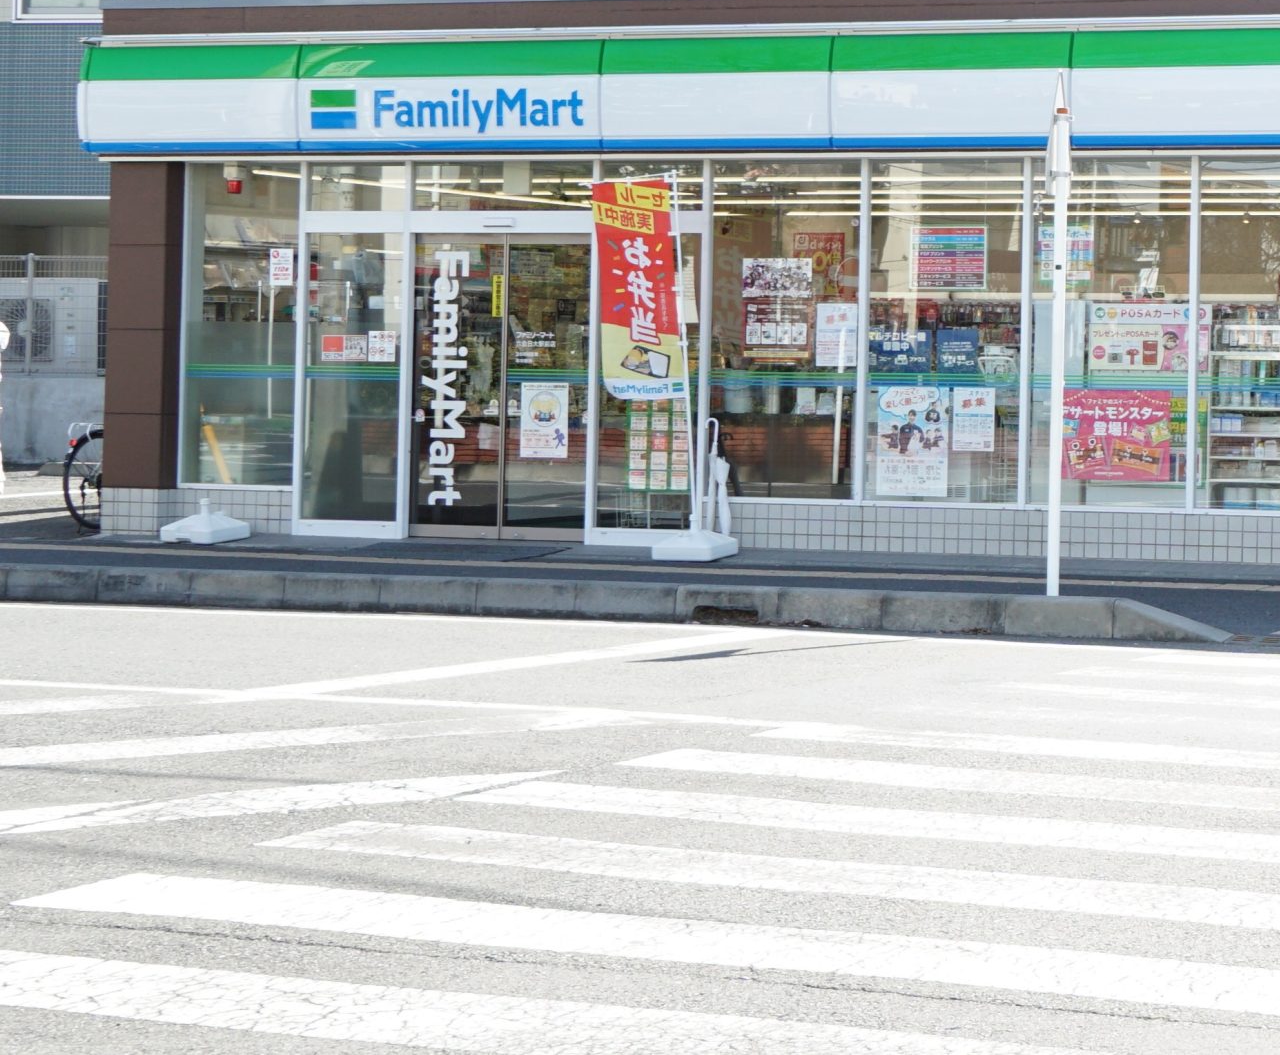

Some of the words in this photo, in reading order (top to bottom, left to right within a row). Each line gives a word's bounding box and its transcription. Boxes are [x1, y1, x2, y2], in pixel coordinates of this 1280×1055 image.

[374, 88, 584, 133] FamilyMart
[1120, 308, 1181, 319] POSAカード
[421, 250, 470, 506] FamilyMart
